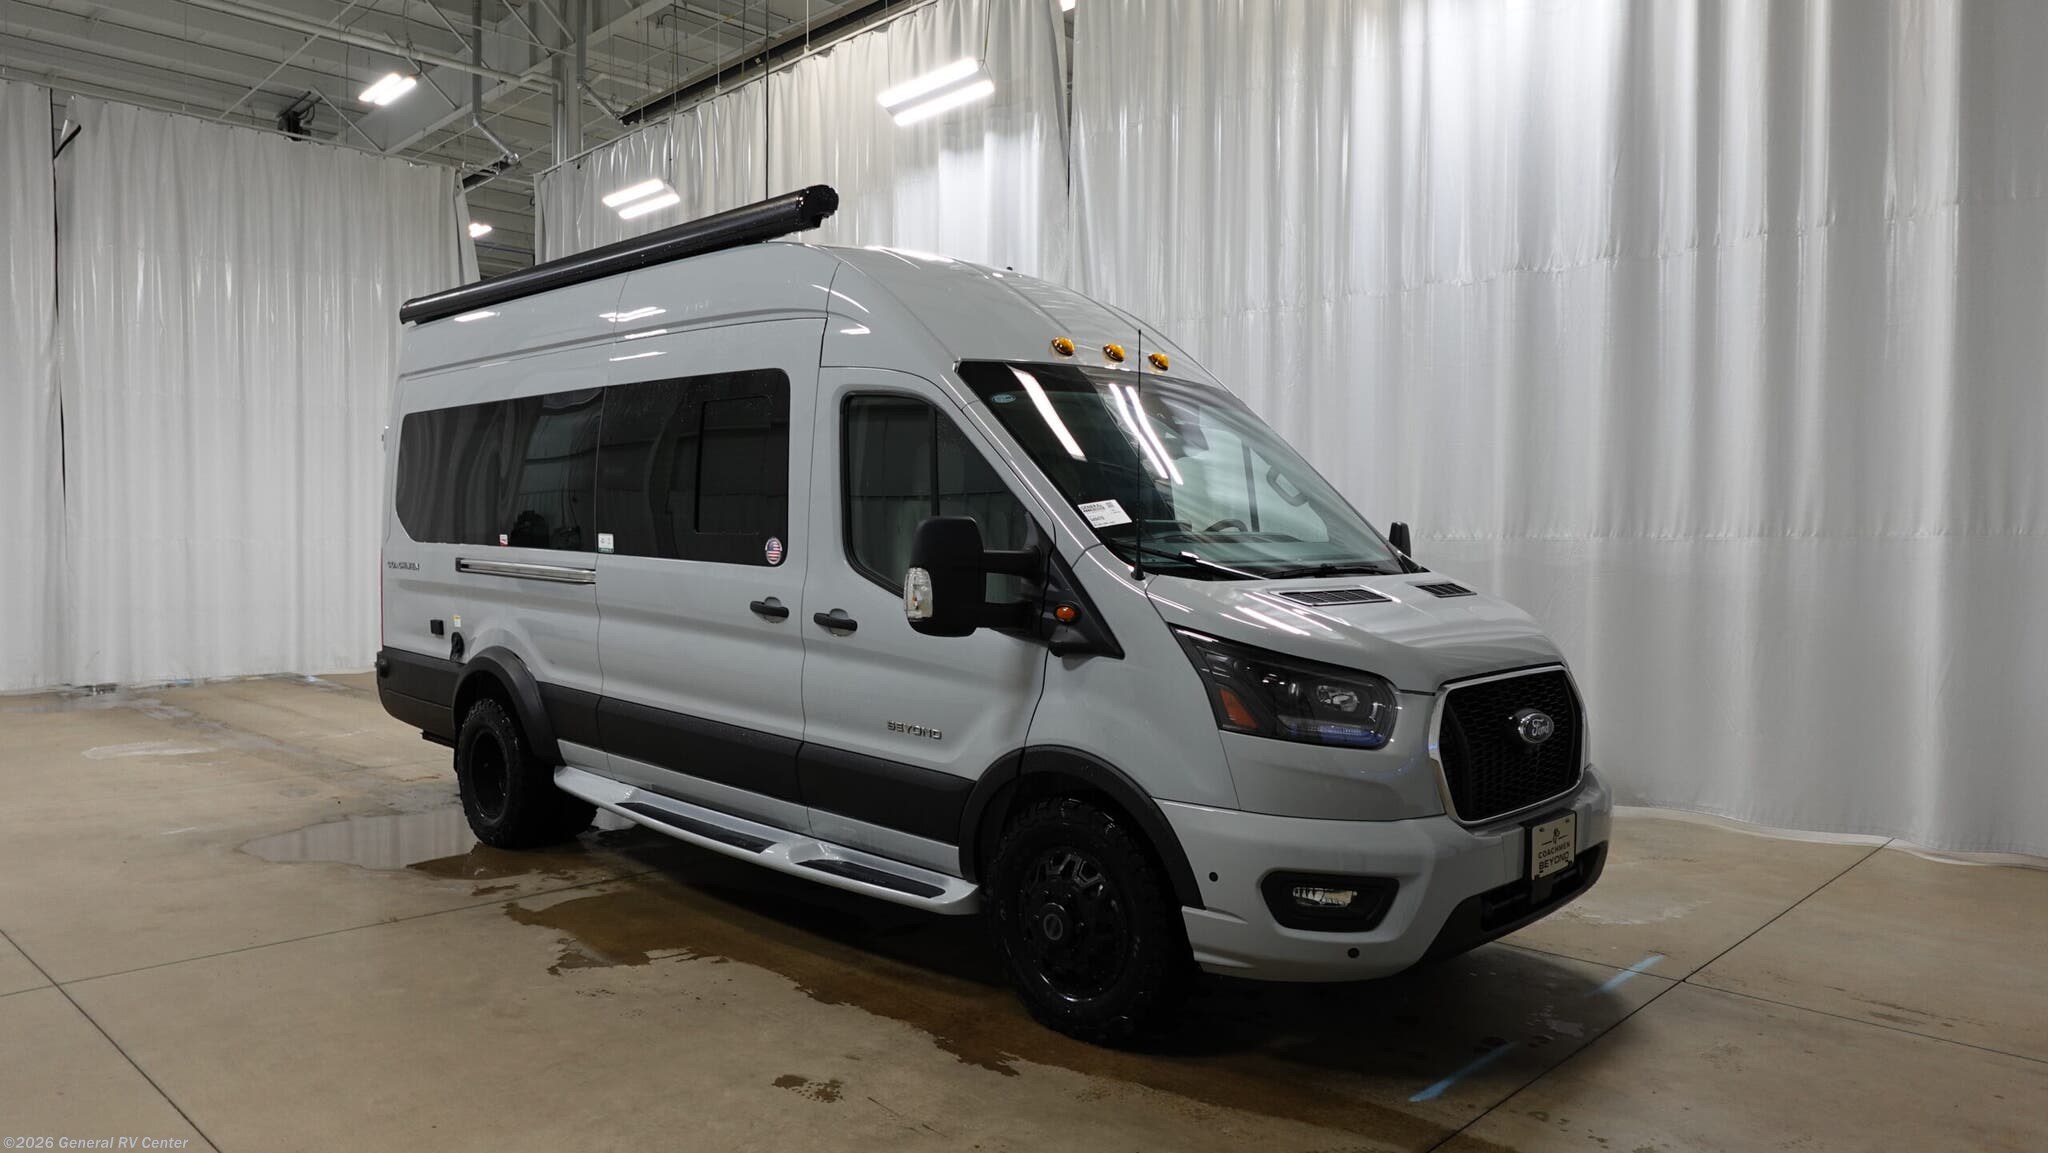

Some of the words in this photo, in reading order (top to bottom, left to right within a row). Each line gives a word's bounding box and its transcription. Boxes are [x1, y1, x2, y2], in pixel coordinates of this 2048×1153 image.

[887, 721, 943, 740] BEYOND
[1532, 718, 1549, 736] Ford
[1538, 842, 1570, 859] COACHMEN
[1538, 851, 1569, 870] BEYOND
